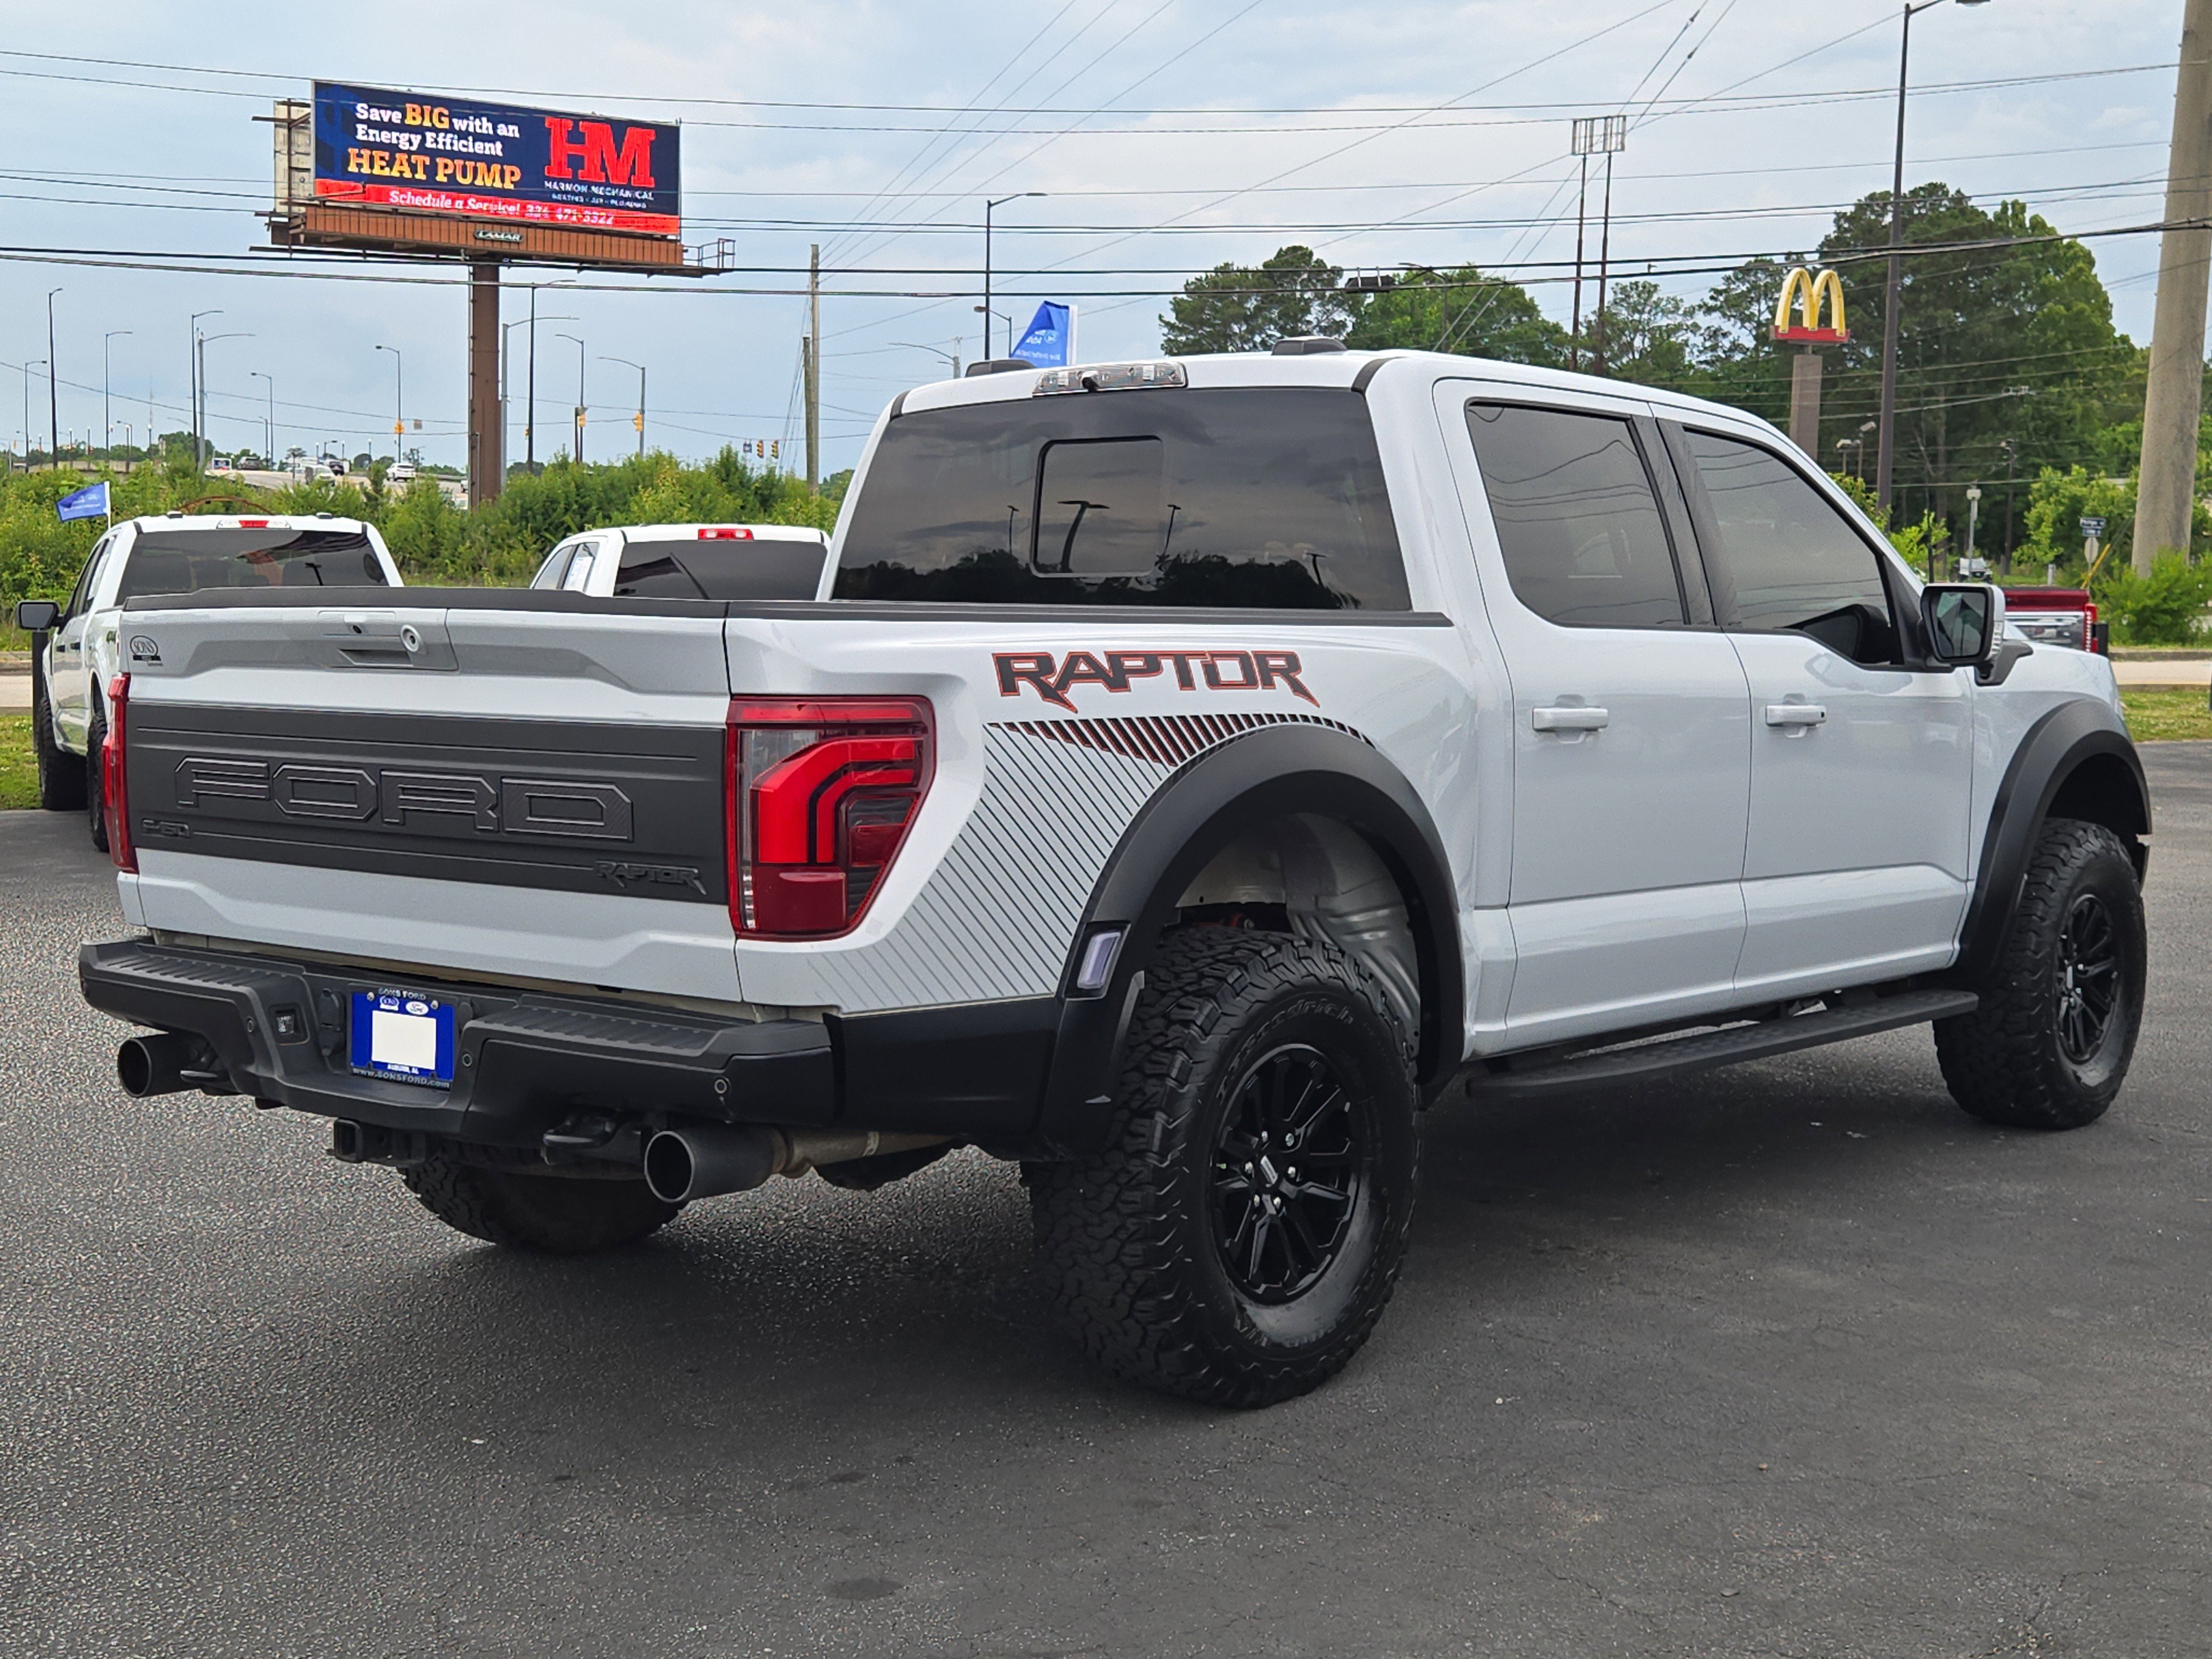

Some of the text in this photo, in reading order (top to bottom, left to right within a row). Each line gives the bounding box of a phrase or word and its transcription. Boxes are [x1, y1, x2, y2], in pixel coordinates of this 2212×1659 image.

[356, 103, 519, 138] Save BIG with an
[356, 124, 503, 157] Energy Efficient
[544, 117, 656, 188] HM
[348, 147, 522, 189] HEAT PUMP
[389, 190, 452, 208] Schedule
[454, 199, 464, 209] a
[466, 197, 521, 215] Service!
[992, 650, 1320, 714] RAPTOR
[174, 755, 635, 843] FORD
[595, 860, 707, 896] RAPTOR
